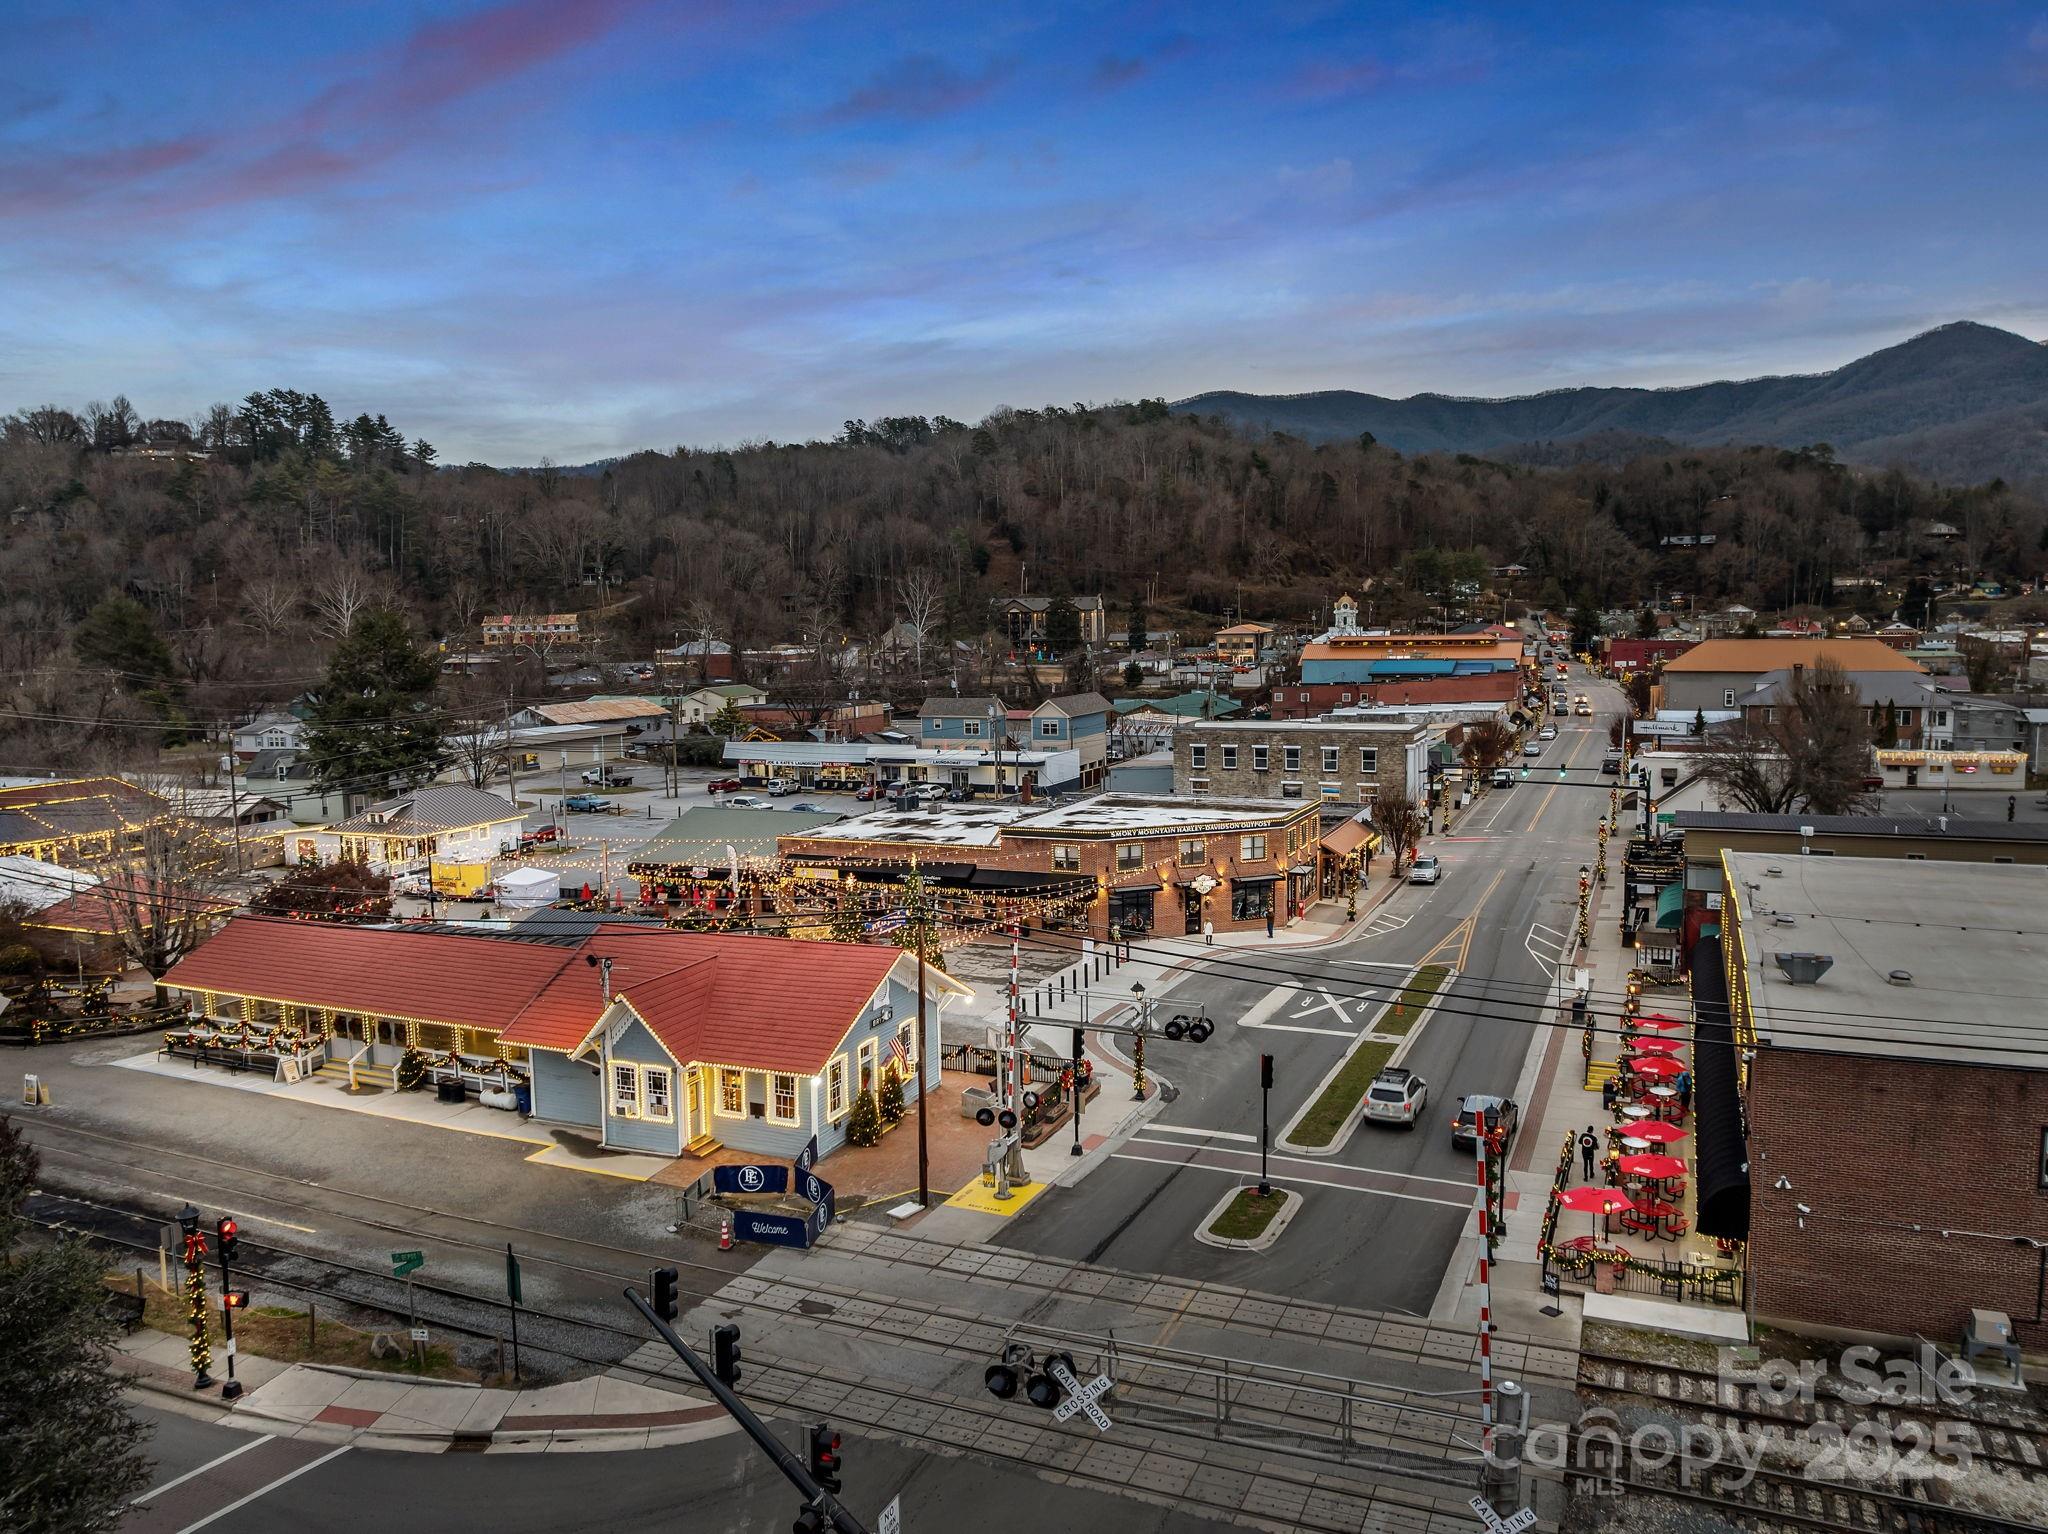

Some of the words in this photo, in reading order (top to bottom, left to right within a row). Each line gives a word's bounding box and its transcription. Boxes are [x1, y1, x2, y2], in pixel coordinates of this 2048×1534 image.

[1640, 723, 1680, 732] Hallmark
[1110, 829, 1137, 838] SMOKY
[1137, 825, 1176, 836] MOUNTAIN
[1176, 822, 1240, 833] HARLEY-DAVIDSON
[1240, 819, 1272, 829] OUTPOST
[751, 1222, 789, 1235] Welcome
[1056, 1367, 1077, 1394] RAIL
[1057, 1378, 1107, 1419] CROSSING
[1085, 1402, 1109, 1429] ROAD
[884, 1505, 895, 1524] NO
[1471, 1497, 1498, 1528] RAIL
